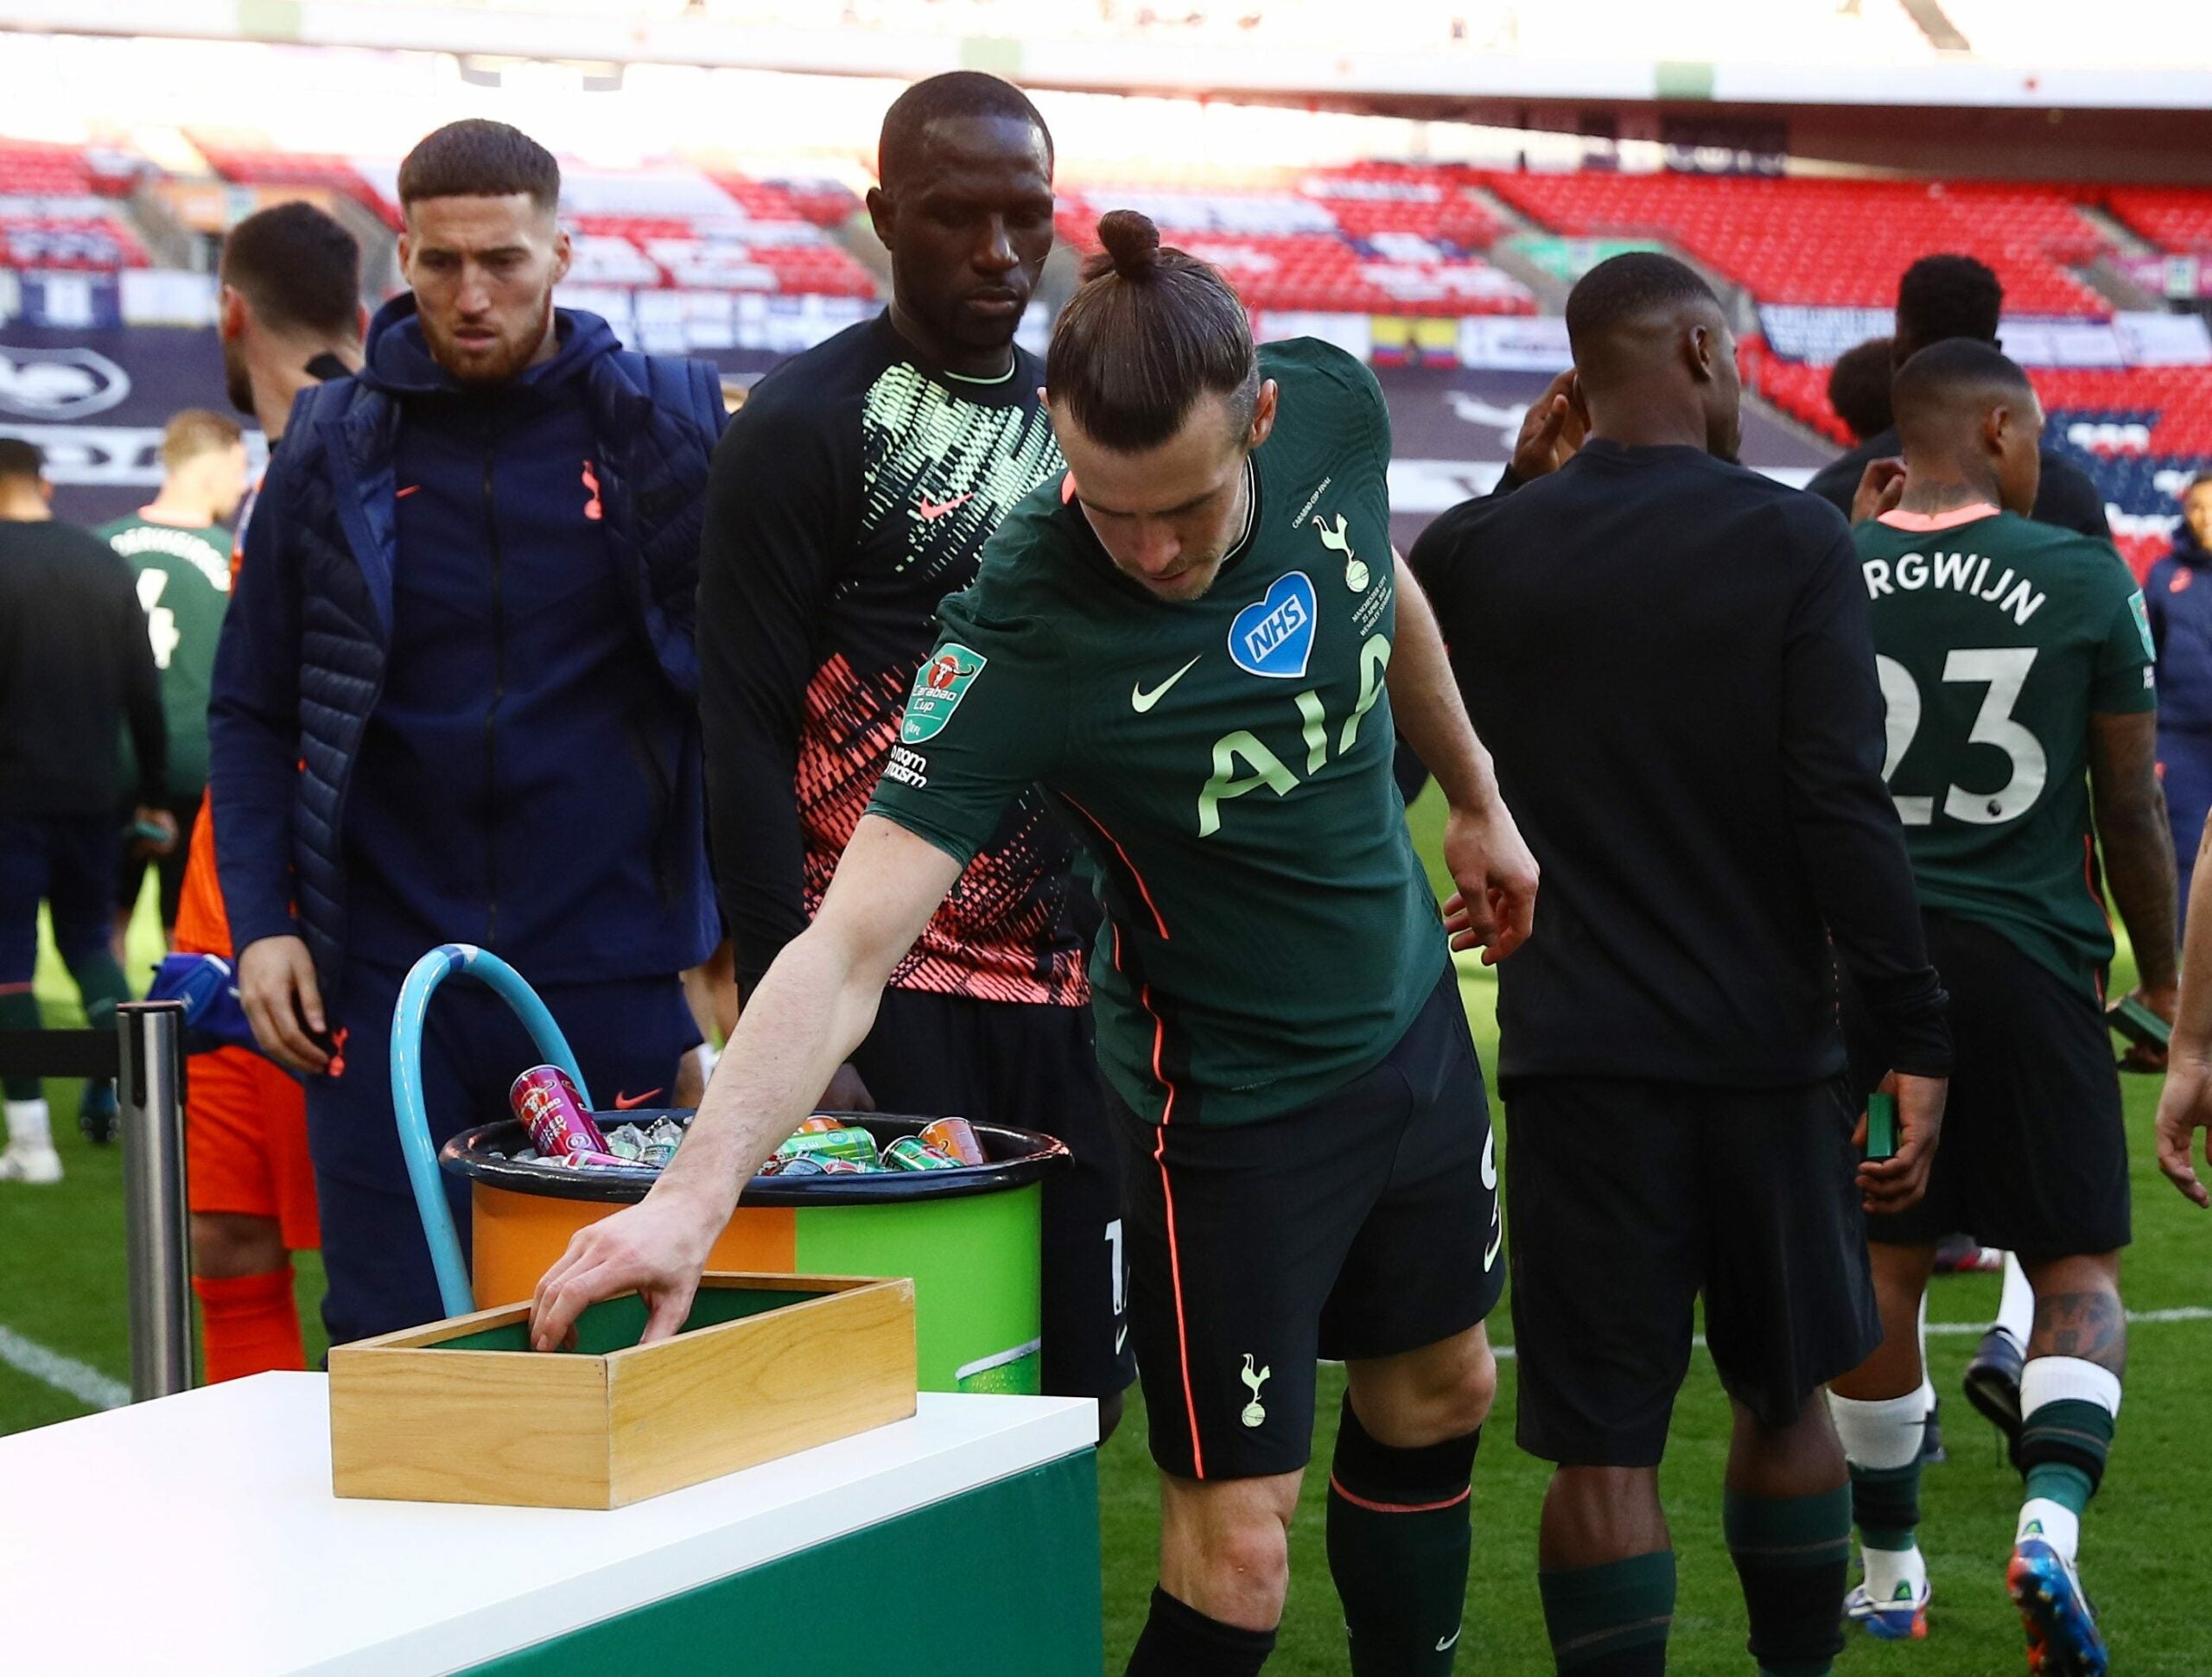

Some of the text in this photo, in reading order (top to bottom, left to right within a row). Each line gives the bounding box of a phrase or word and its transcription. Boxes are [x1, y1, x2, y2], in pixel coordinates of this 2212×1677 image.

[1292, 476, 1332, 529] CARABAO CUP FINAL
[1351, 573, 1387, 623] MANCHESTER CITY
[1362, 613, 1369, 623] 25
[1367, 599, 1380, 617] APRIL
[1861, 551, 2047, 627] RGWIJN
[1251, 598, 1301, 659] NHS
[1359, 609, 1381, 637] WEMBLEY
[911, 684, 957, 702] Carabao
[913, 697, 935, 713] Cup
[894, 746, 927, 773] room
[1875, 646, 2049, 826] 23
[1104, 1218, 1130, 1316] 1
